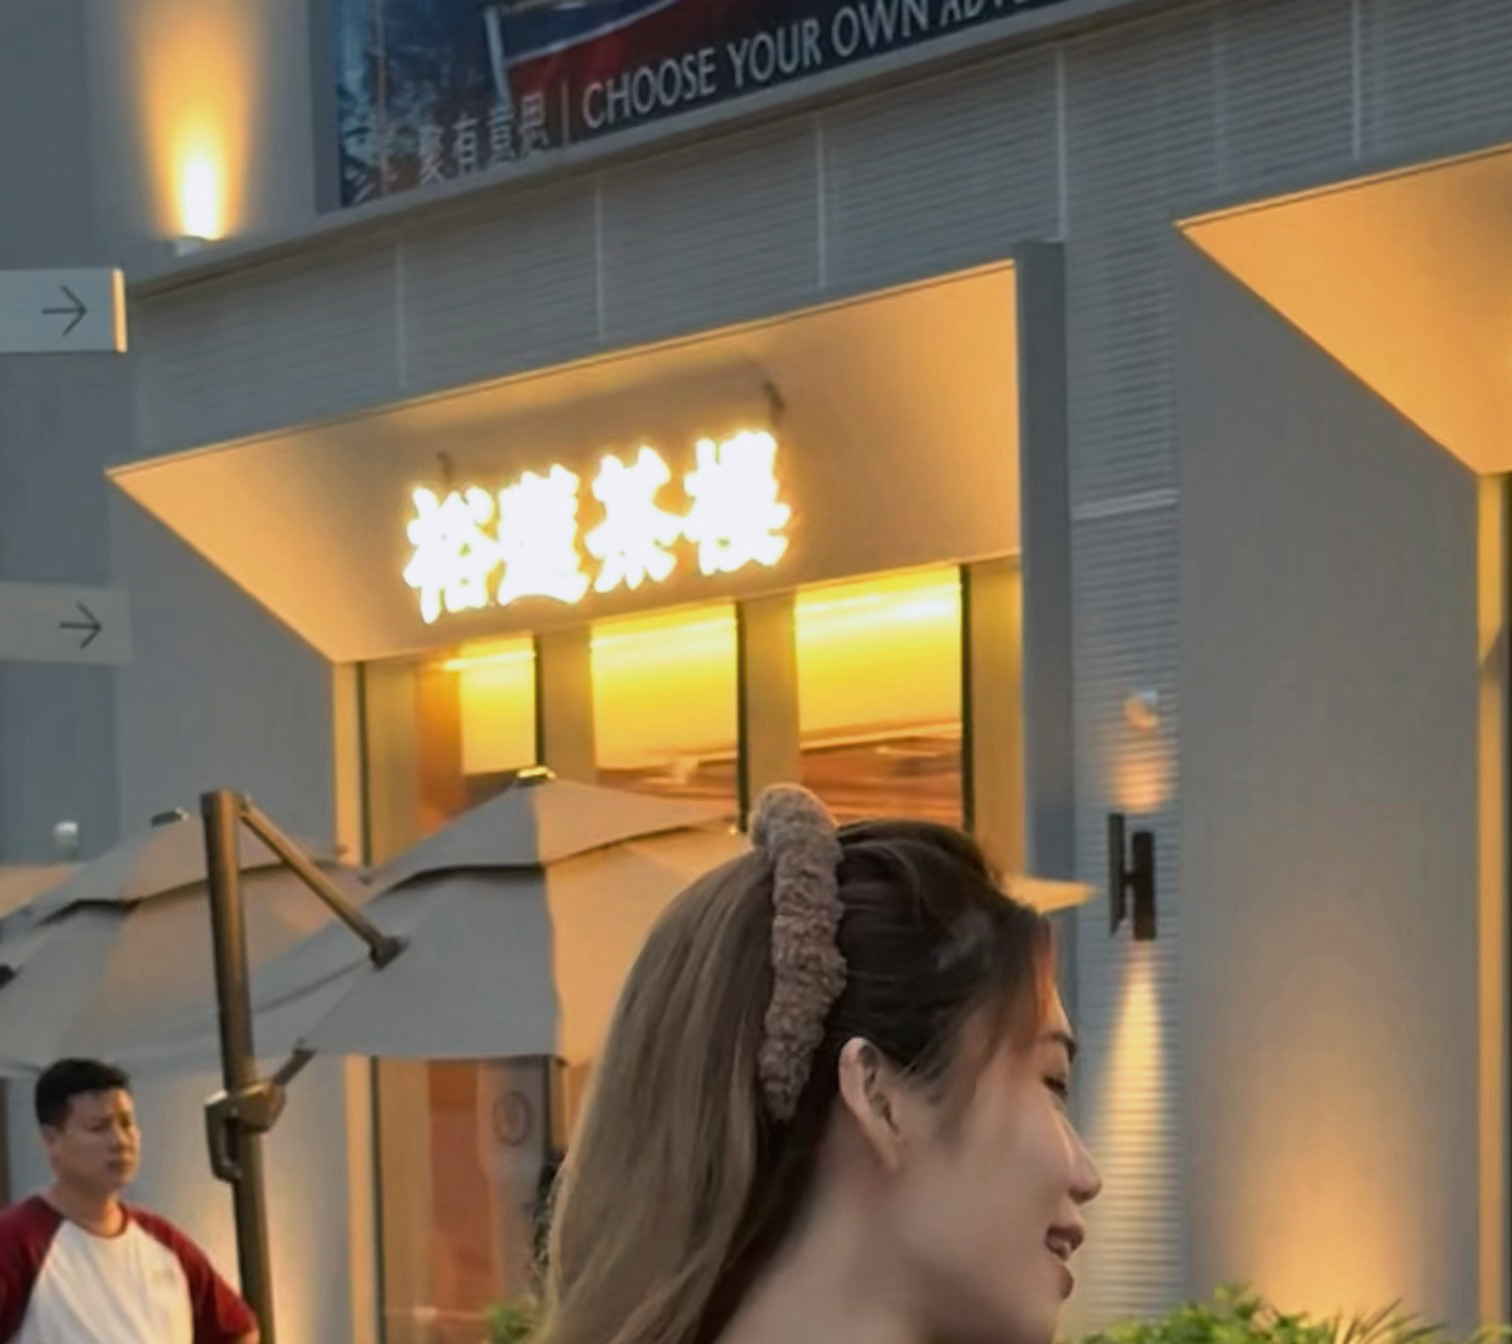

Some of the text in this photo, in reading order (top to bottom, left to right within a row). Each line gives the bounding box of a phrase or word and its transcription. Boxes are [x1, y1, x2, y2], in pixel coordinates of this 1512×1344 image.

[582, 0, 930, 130] CHOOSE YOUR OWN
